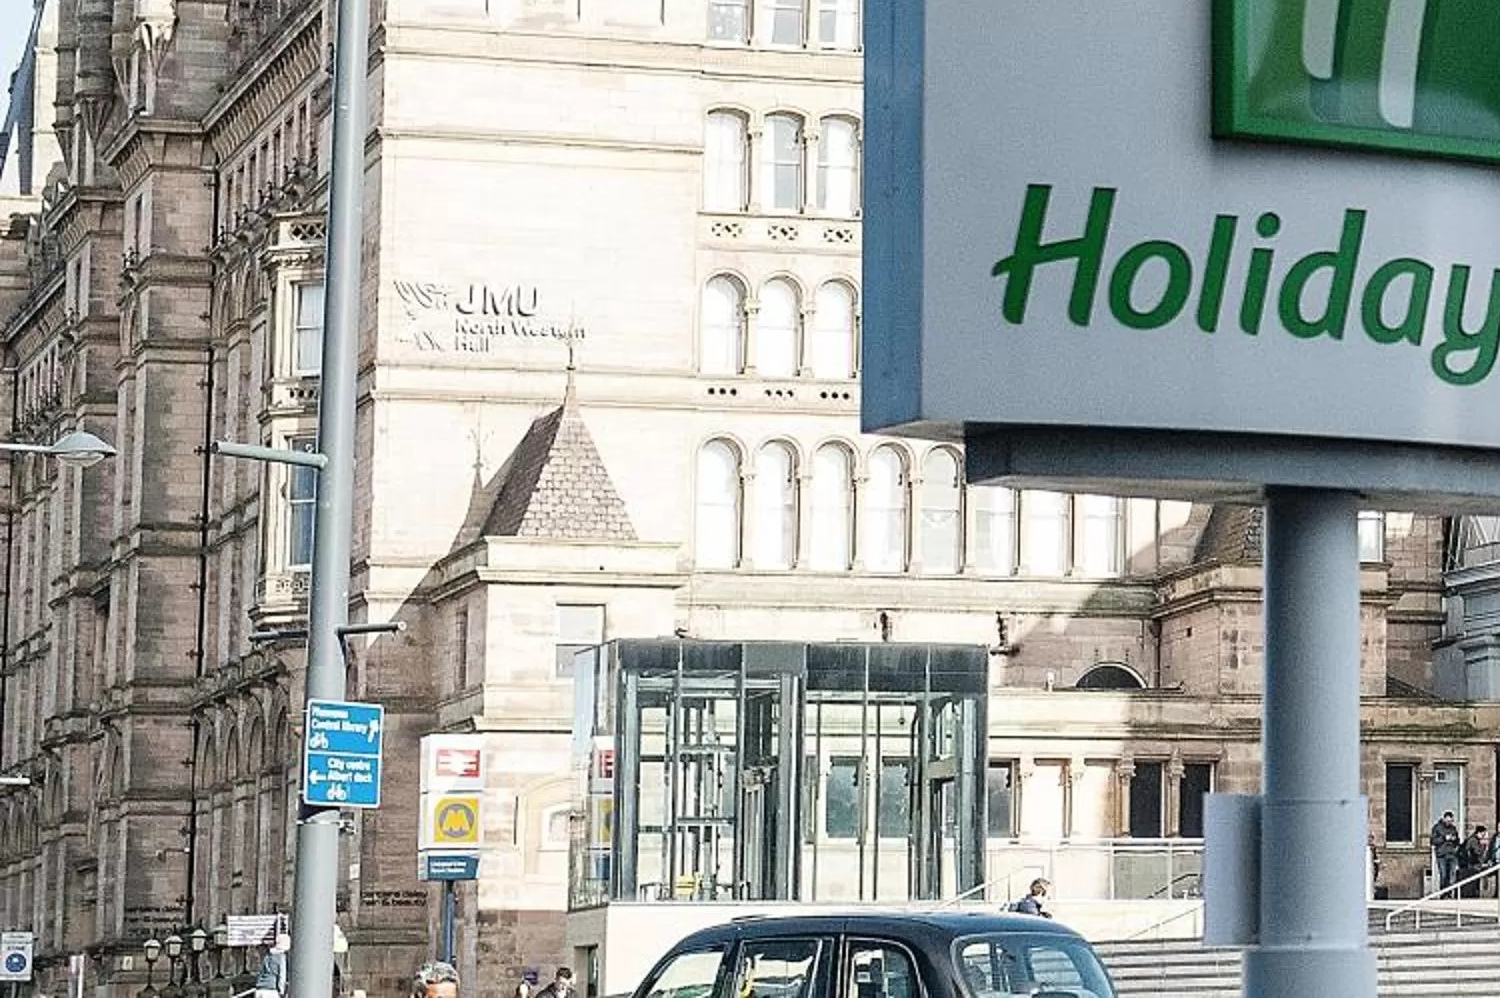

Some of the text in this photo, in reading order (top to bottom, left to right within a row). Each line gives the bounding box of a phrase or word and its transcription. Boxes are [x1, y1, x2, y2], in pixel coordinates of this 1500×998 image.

[455, 283, 539, 317] JMU
[454, 318, 506, 335] North
[454, 335, 490, 353] Hall
[328, 757, 345, 771] City
